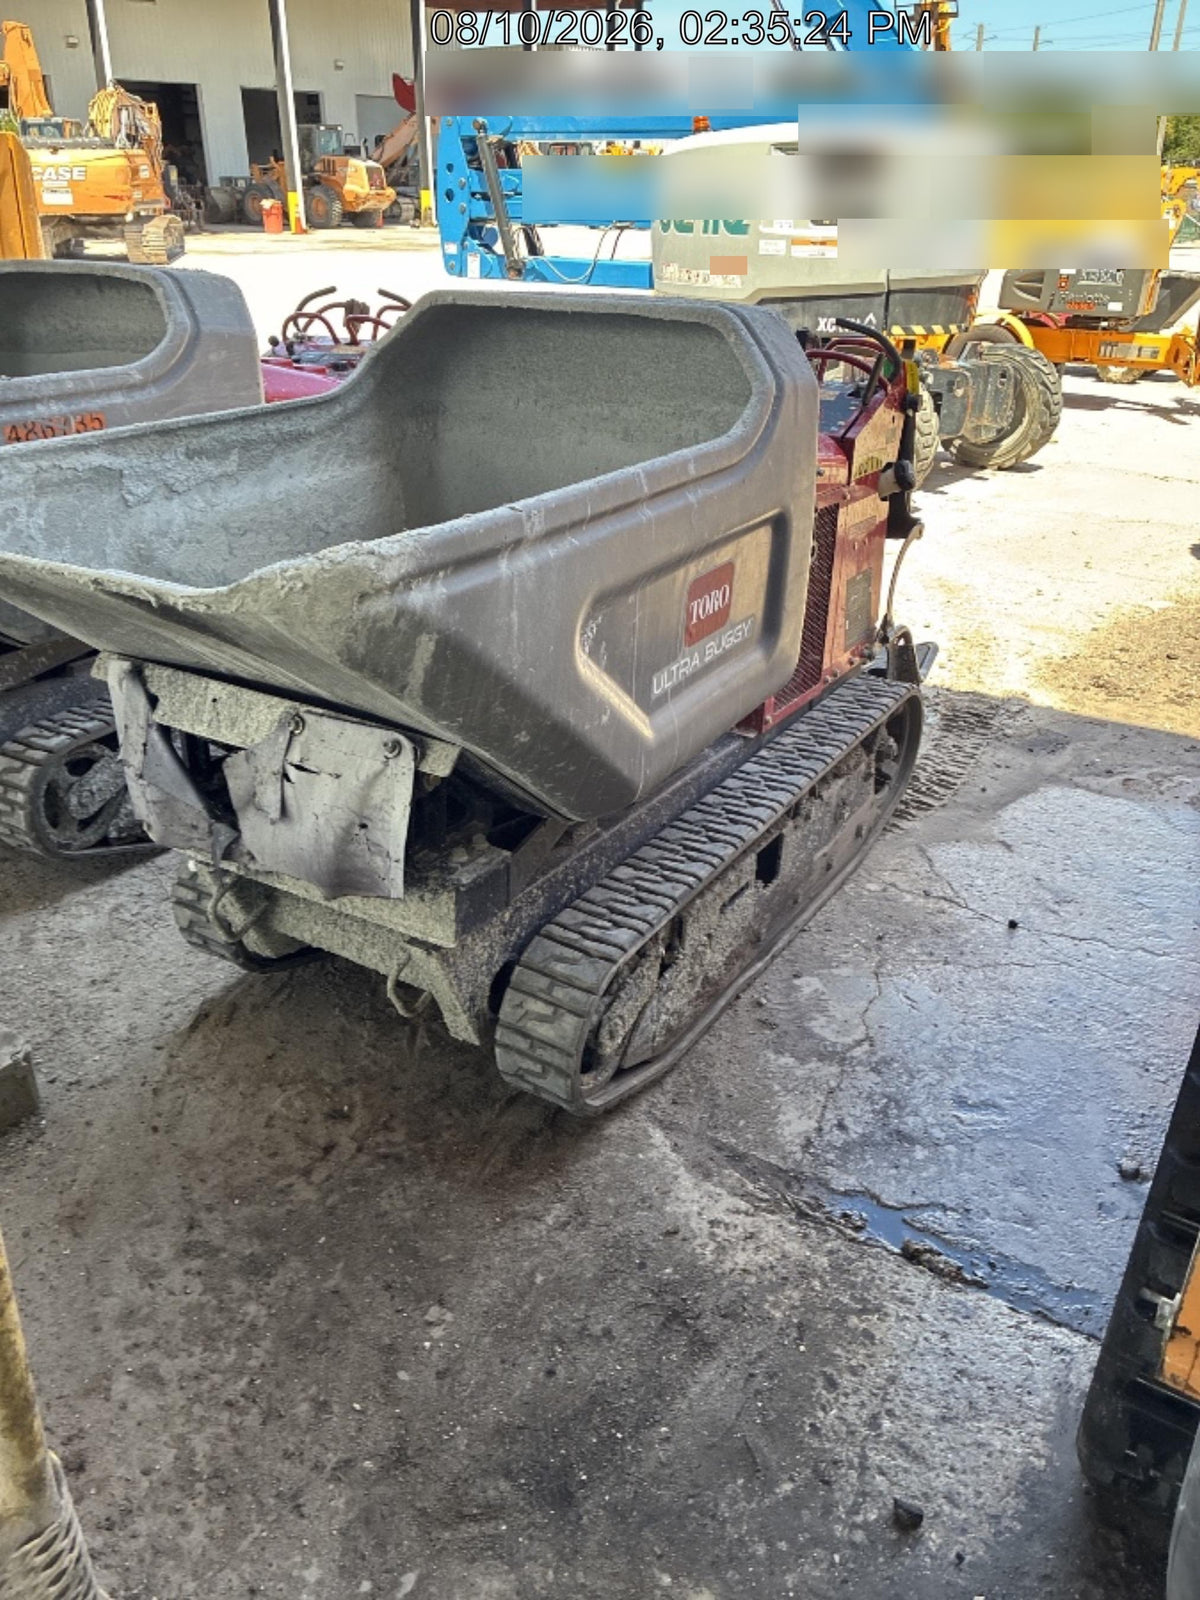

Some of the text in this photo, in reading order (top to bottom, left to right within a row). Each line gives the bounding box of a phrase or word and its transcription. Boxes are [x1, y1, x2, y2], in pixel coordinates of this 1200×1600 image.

[31, 165, 87, 181] CASE
[689, 583, 730, 625] TORO
[652, 617, 755, 695] ULTRA BUGGY
